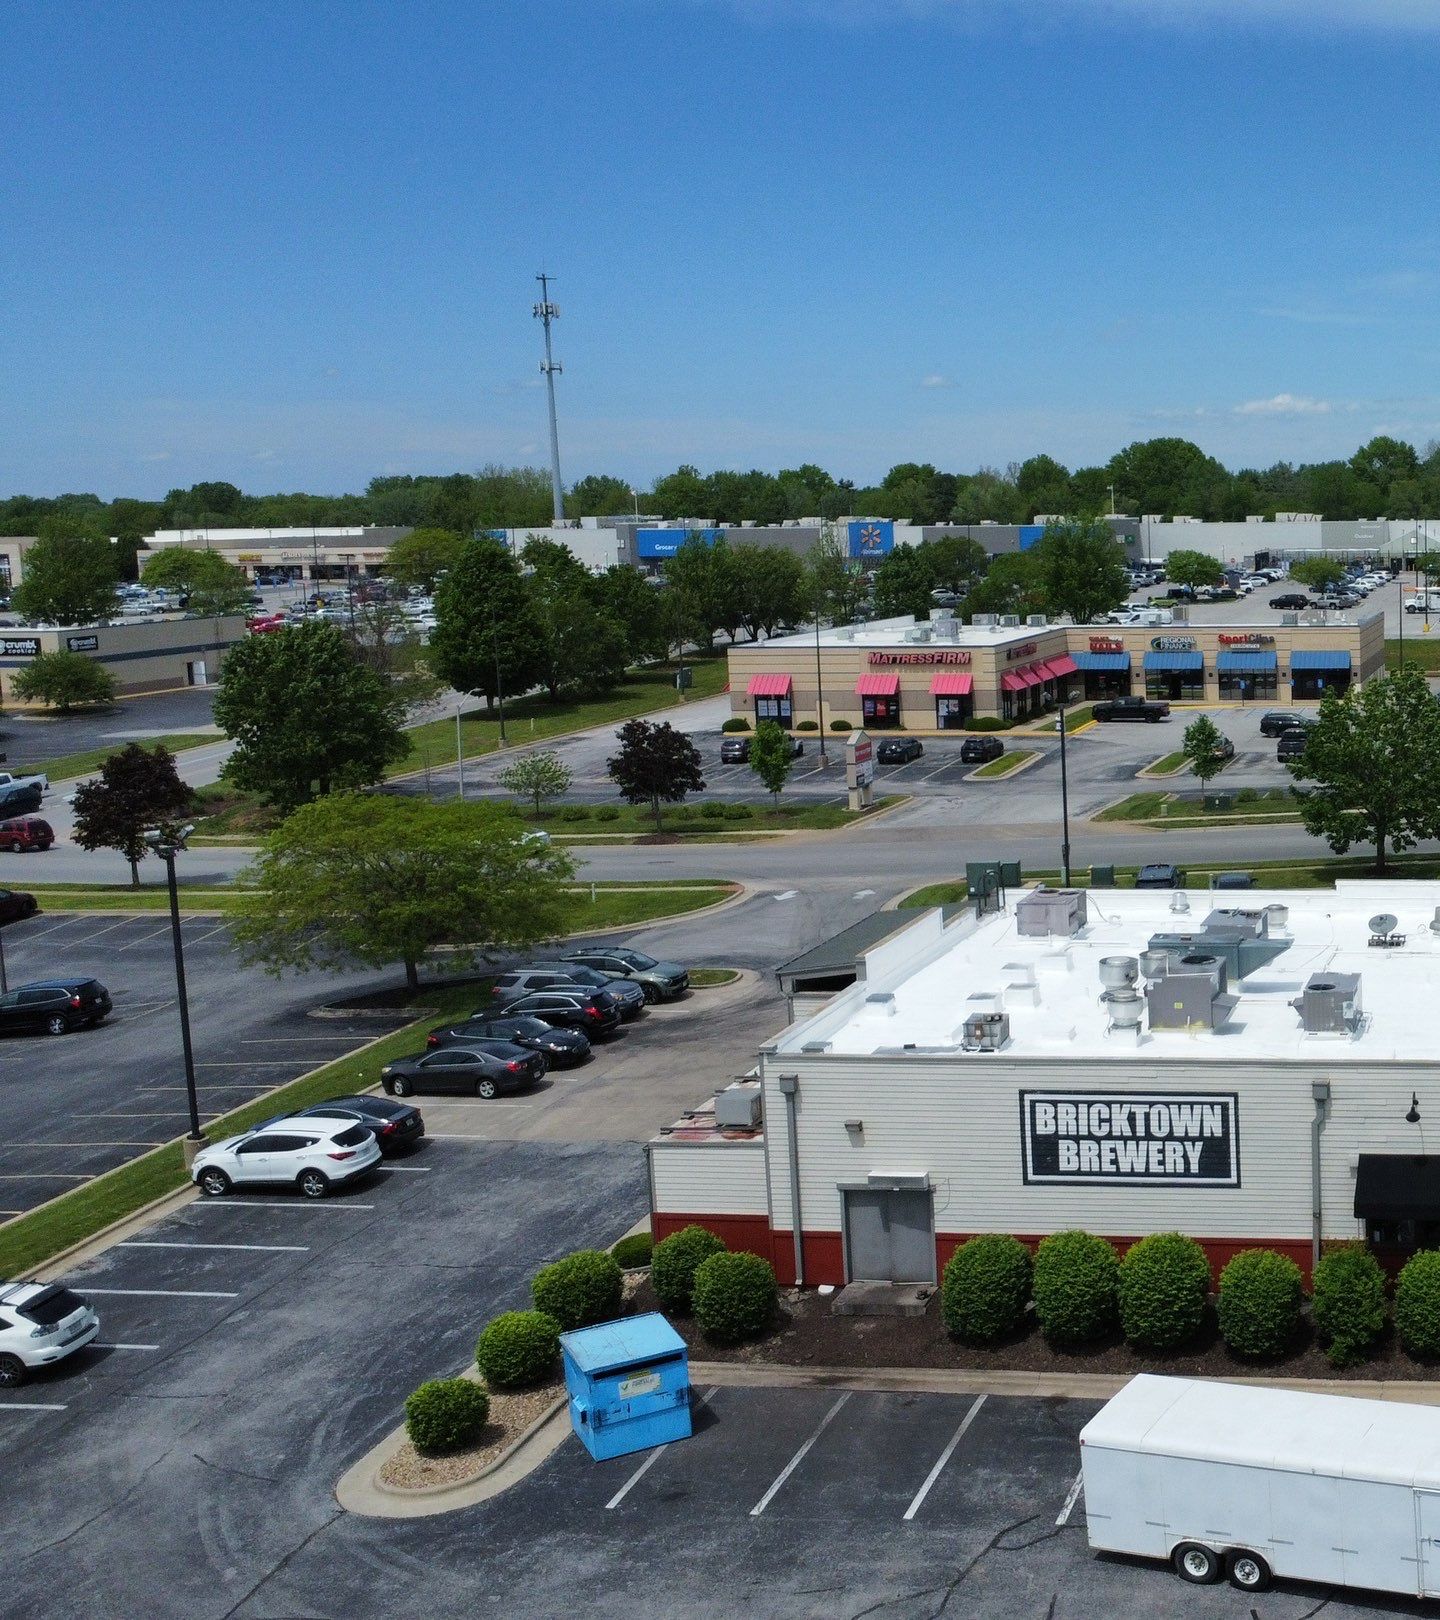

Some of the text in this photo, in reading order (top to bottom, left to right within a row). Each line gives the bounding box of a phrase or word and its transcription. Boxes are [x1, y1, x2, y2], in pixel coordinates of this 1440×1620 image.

[6, 640, 37, 649] crumbl
[1161, 636, 1196, 644] REGIONAL
[1035, 1102, 1223, 1137] BRICKTOWN
[1058, 1139, 1203, 1173] BREWERY
